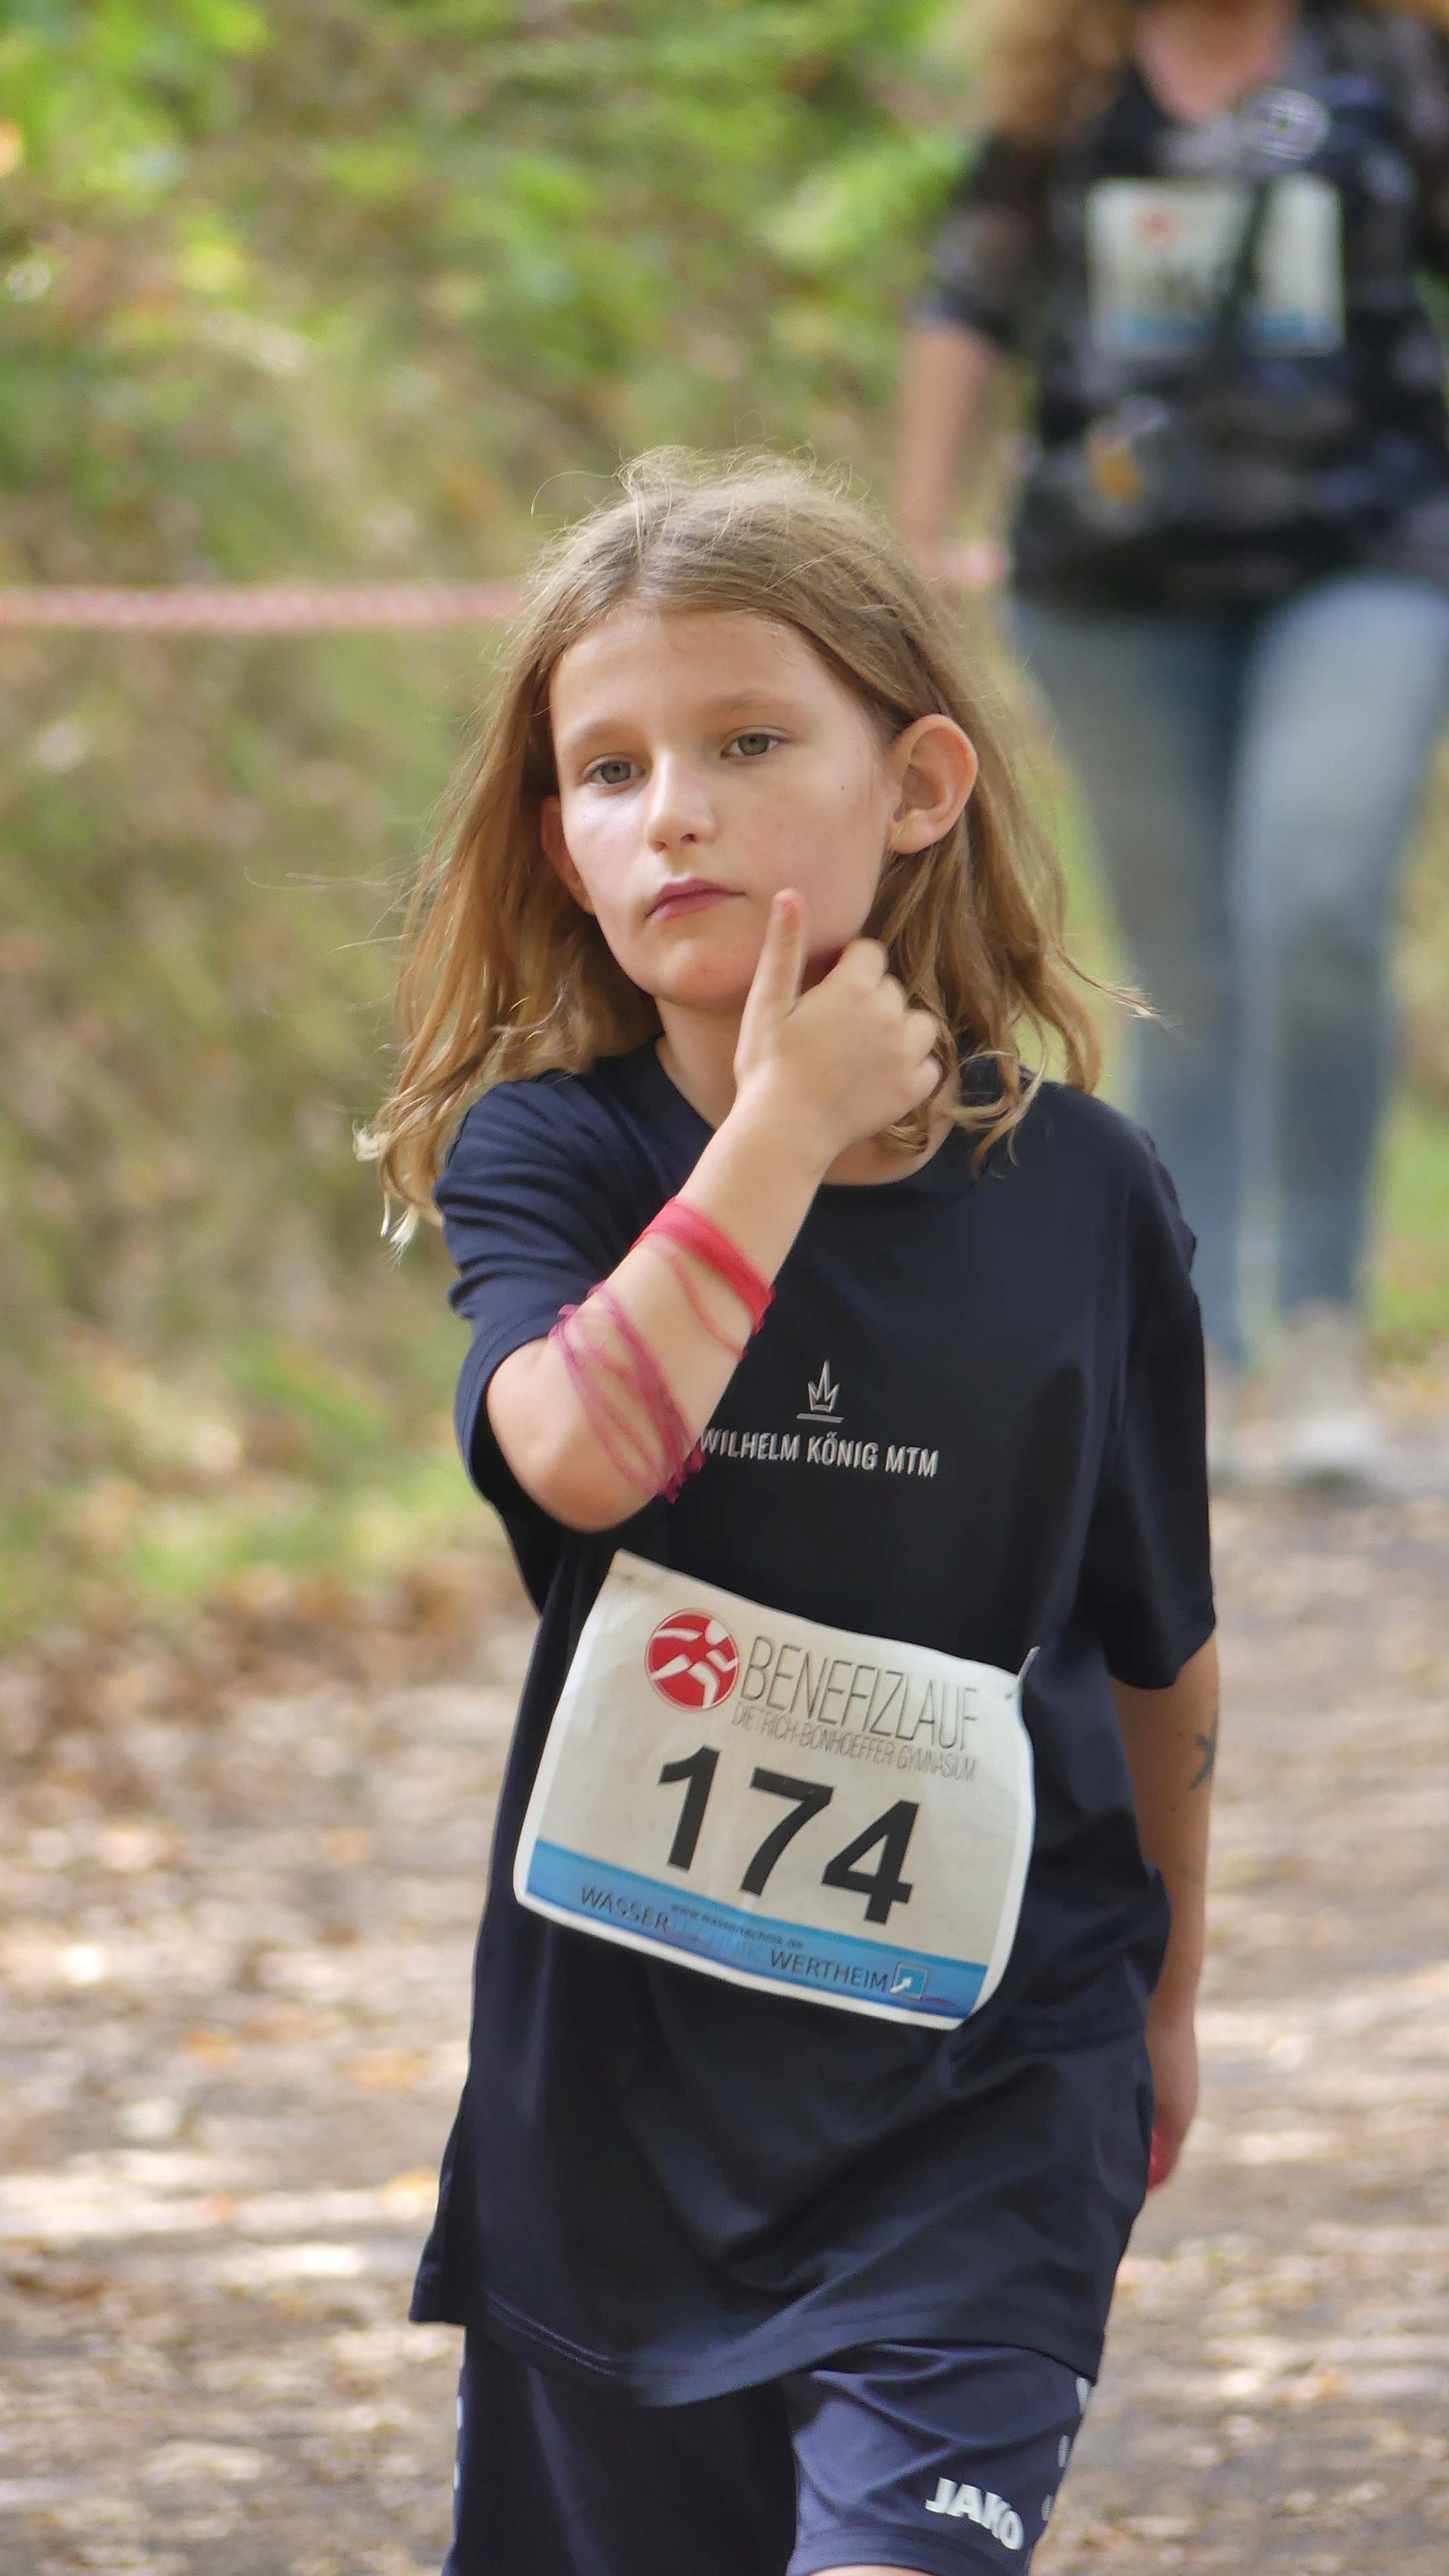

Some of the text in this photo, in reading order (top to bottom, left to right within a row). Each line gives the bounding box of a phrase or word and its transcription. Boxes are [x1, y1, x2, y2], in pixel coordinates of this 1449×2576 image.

[700, 1427, 939, 1479] WILHELM KÖNIG MTM
[740, 1635, 979, 1751] BENEFIZLAUF
[657, 1746, 919, 1927] 174
[770, 1949, 888, 1992] WERTHEIM
[925, 2477, 1024, 2550] JAKO
